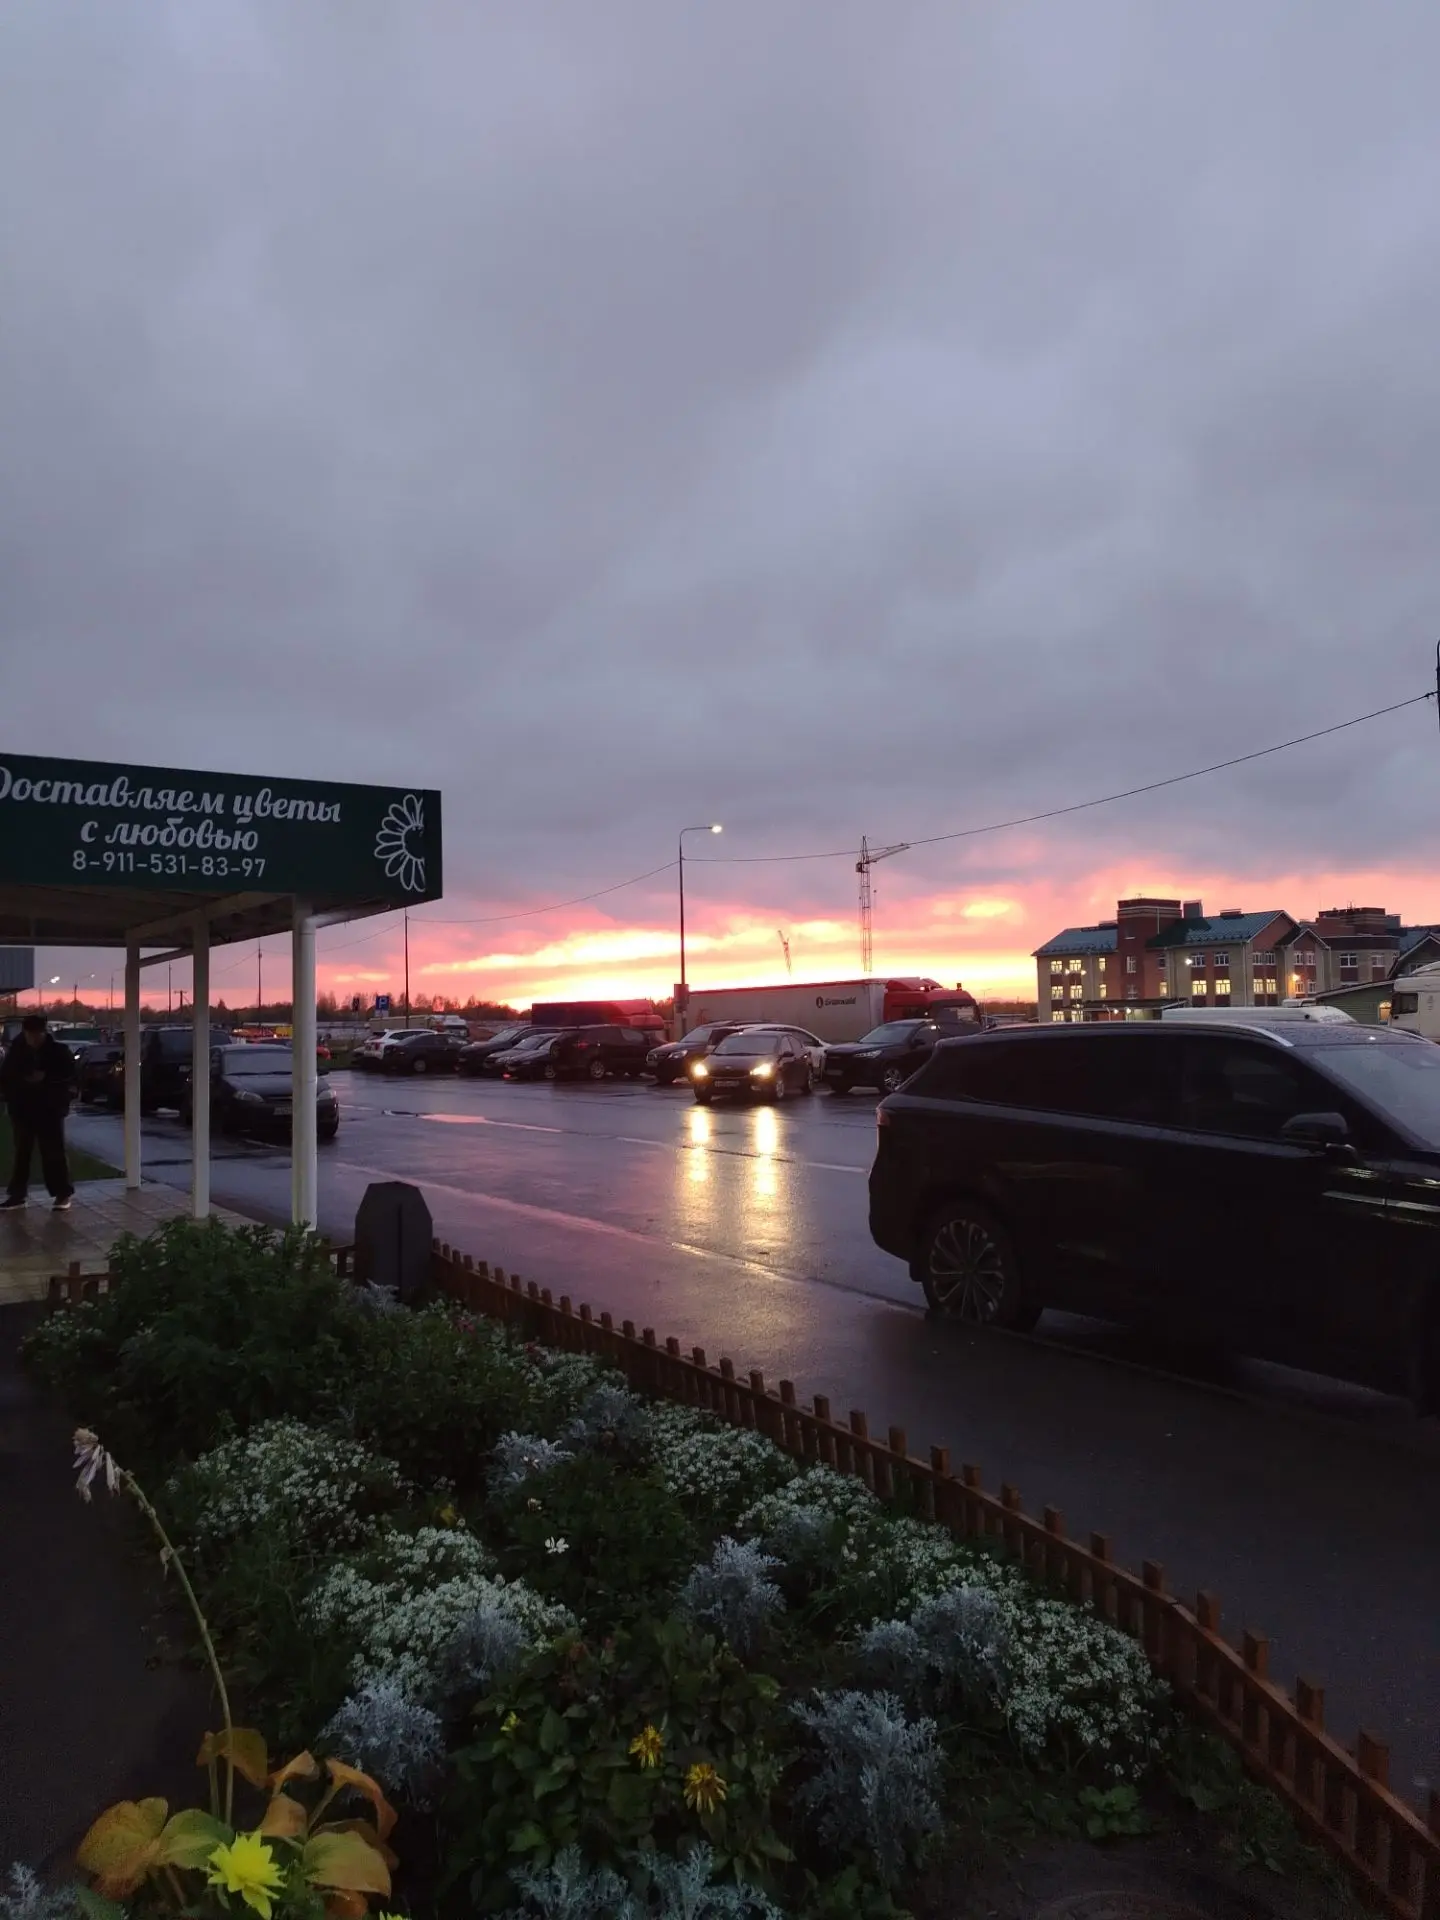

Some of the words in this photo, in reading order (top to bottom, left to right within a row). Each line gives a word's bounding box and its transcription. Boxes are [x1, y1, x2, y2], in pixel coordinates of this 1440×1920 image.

[232, 787, 341, 825] цветы
[80, 820, 99, 843] с
[104, 816, 259, 852] любовью
[72, 849, 267, 878] 8-911-531-83-97
